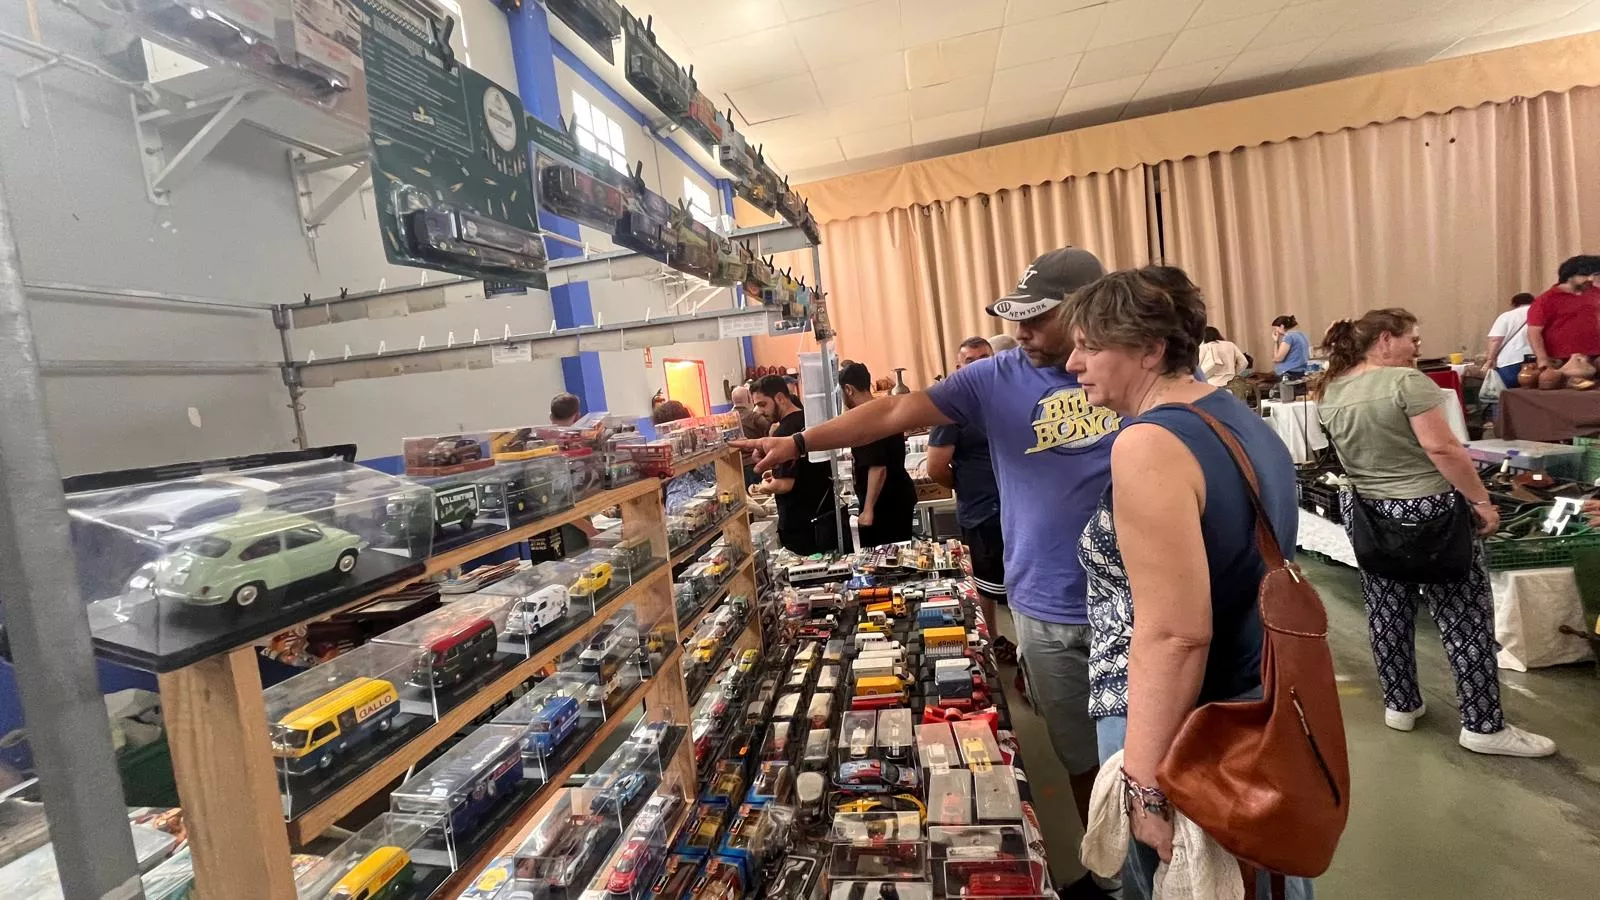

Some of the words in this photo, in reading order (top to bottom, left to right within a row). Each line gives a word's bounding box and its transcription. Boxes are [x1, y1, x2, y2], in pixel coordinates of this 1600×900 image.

[1009, 310, 1026, 319] NEW
[1027, 303, 1047, 314] YORK
[1025, 414, 1123, 454] BONG
[359, 695, 392, 719] GALLO
